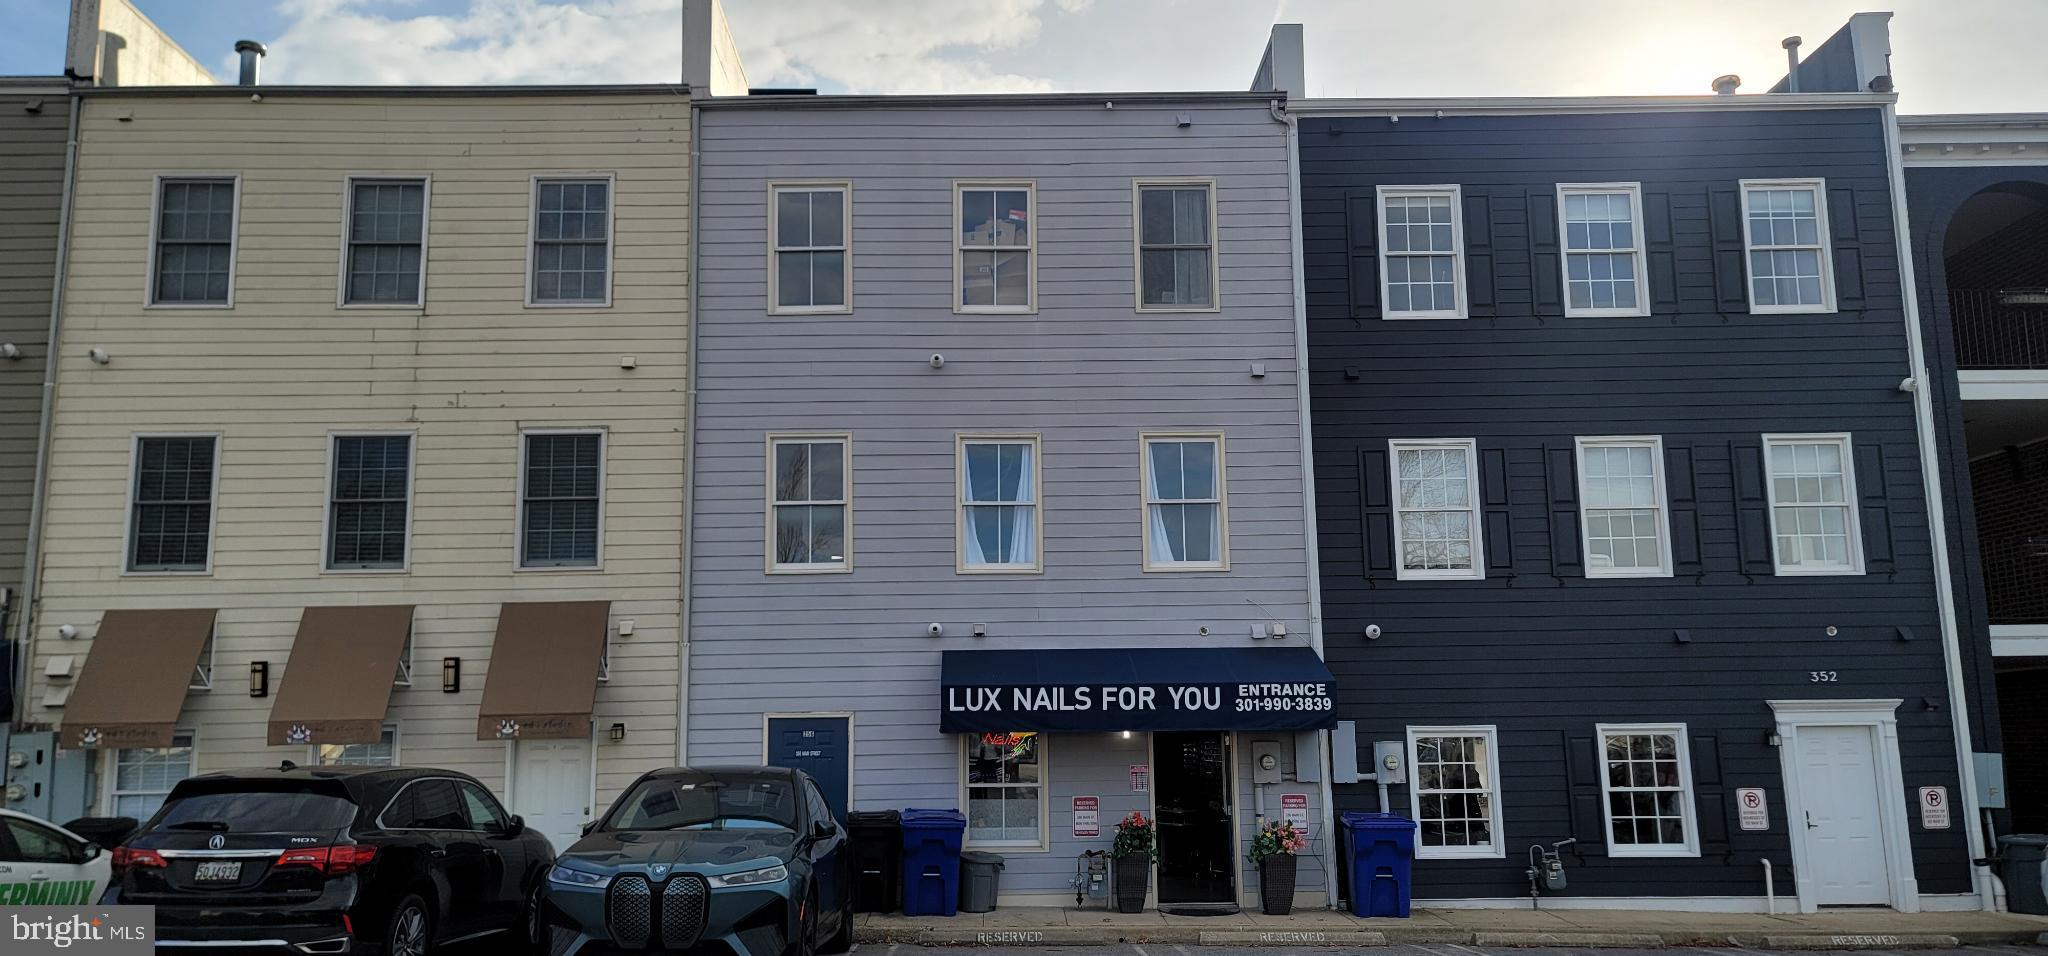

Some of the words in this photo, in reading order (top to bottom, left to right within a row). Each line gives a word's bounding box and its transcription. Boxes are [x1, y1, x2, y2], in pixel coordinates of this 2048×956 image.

[1809, 671, 1838, 682] 352
[1238, 683, 1327, 696] ENTRANCE
[949, 687, 1002, 711] LUX
[1013, 686, 1092, 711] NAILS
[1102, 686, 1156, 710] FOR
[1167, 686, 1221, 710] YOU
[1235, 697, 1332, 711] 301-990-3839
[981, 732, 1020, 746] Nails
[977, 931, 1043, 943] RESERVED
[1260, 931, 1325, 942] RESERVED
[1831, 935, 1900, 945] RESERVED
